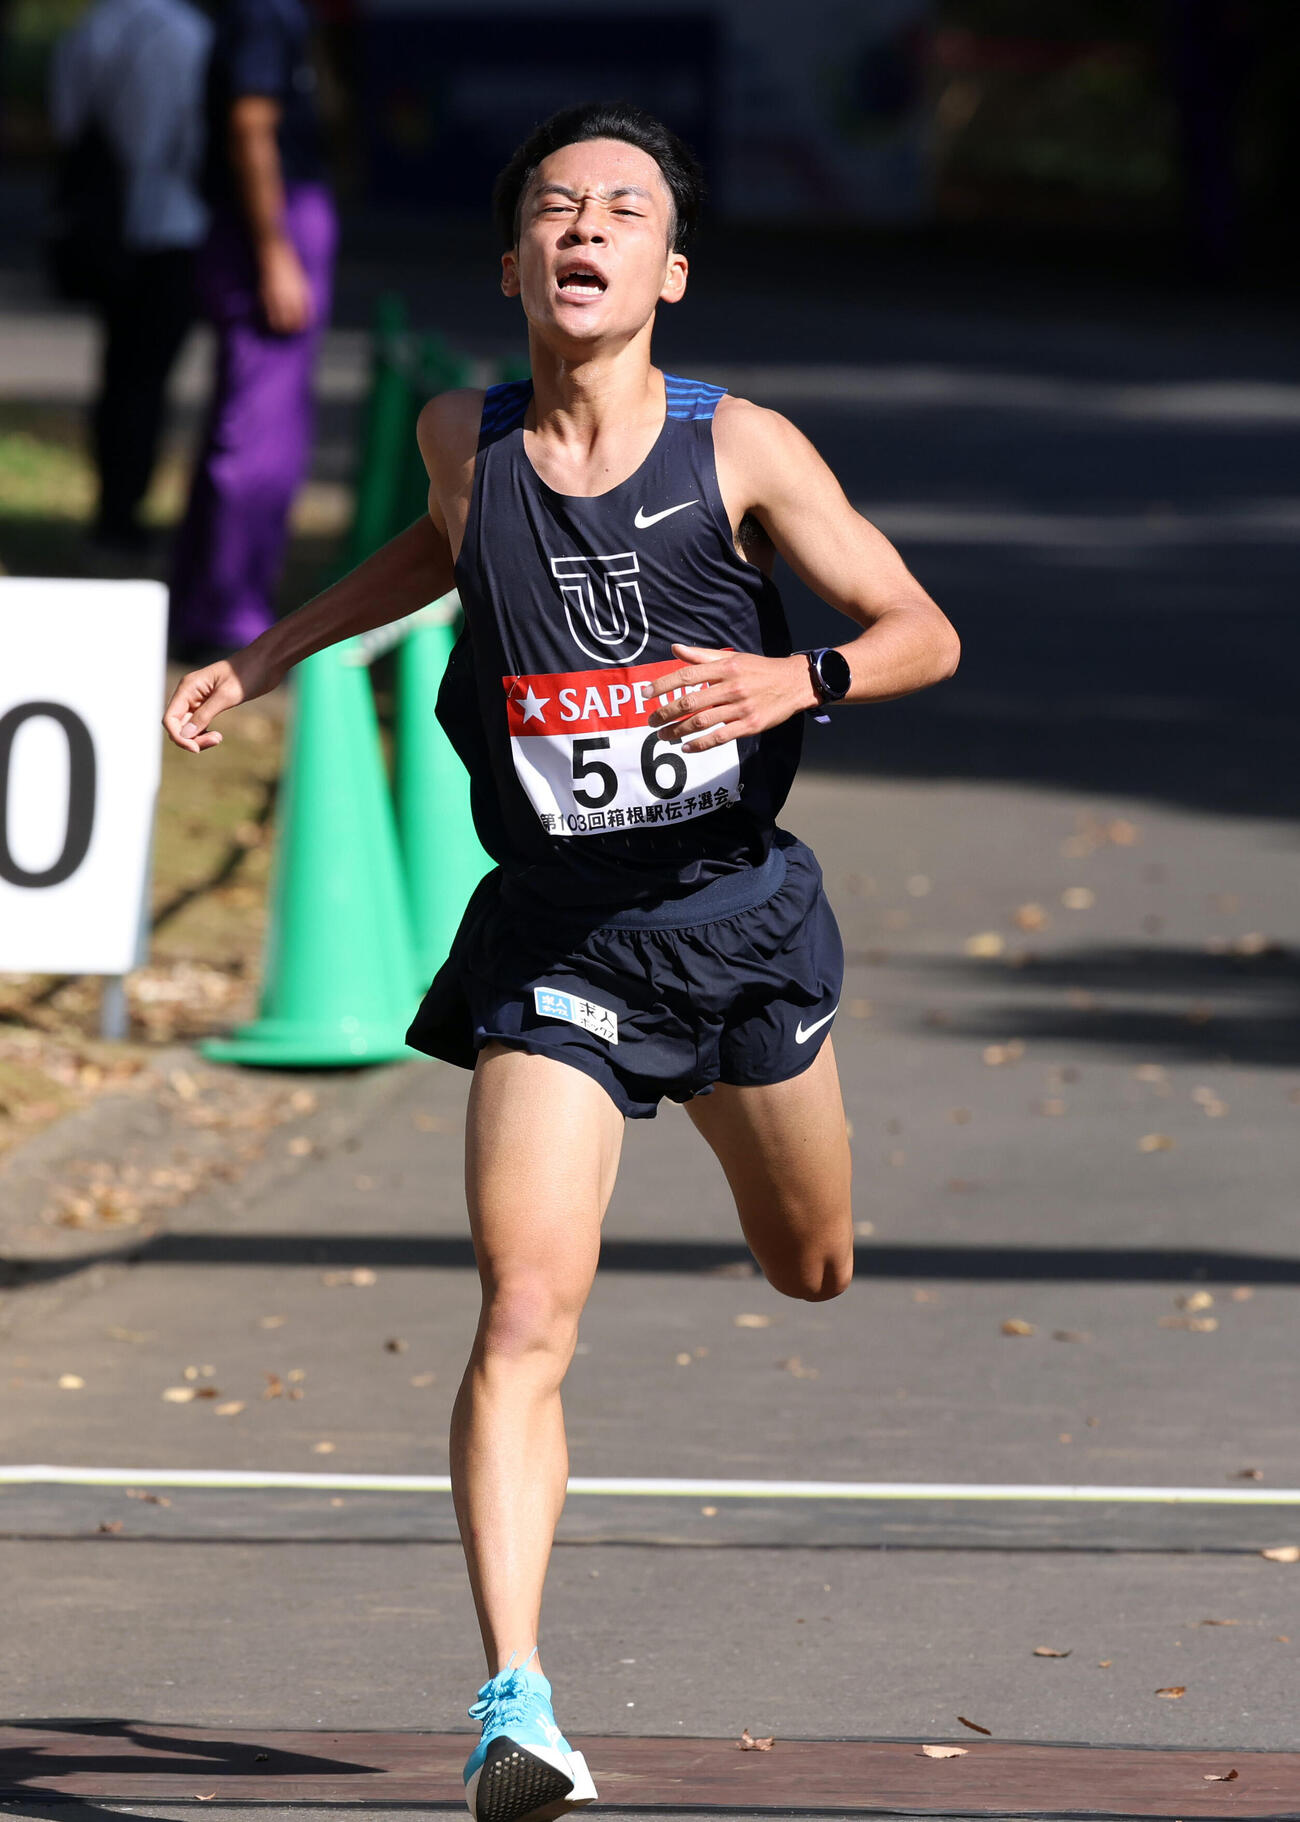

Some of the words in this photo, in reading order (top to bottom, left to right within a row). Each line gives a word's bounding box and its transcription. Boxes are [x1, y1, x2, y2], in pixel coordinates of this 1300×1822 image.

[0, 700, 97, 889] 0
[540, 787, 729, 832] 第103回箱根駅伝予選会
